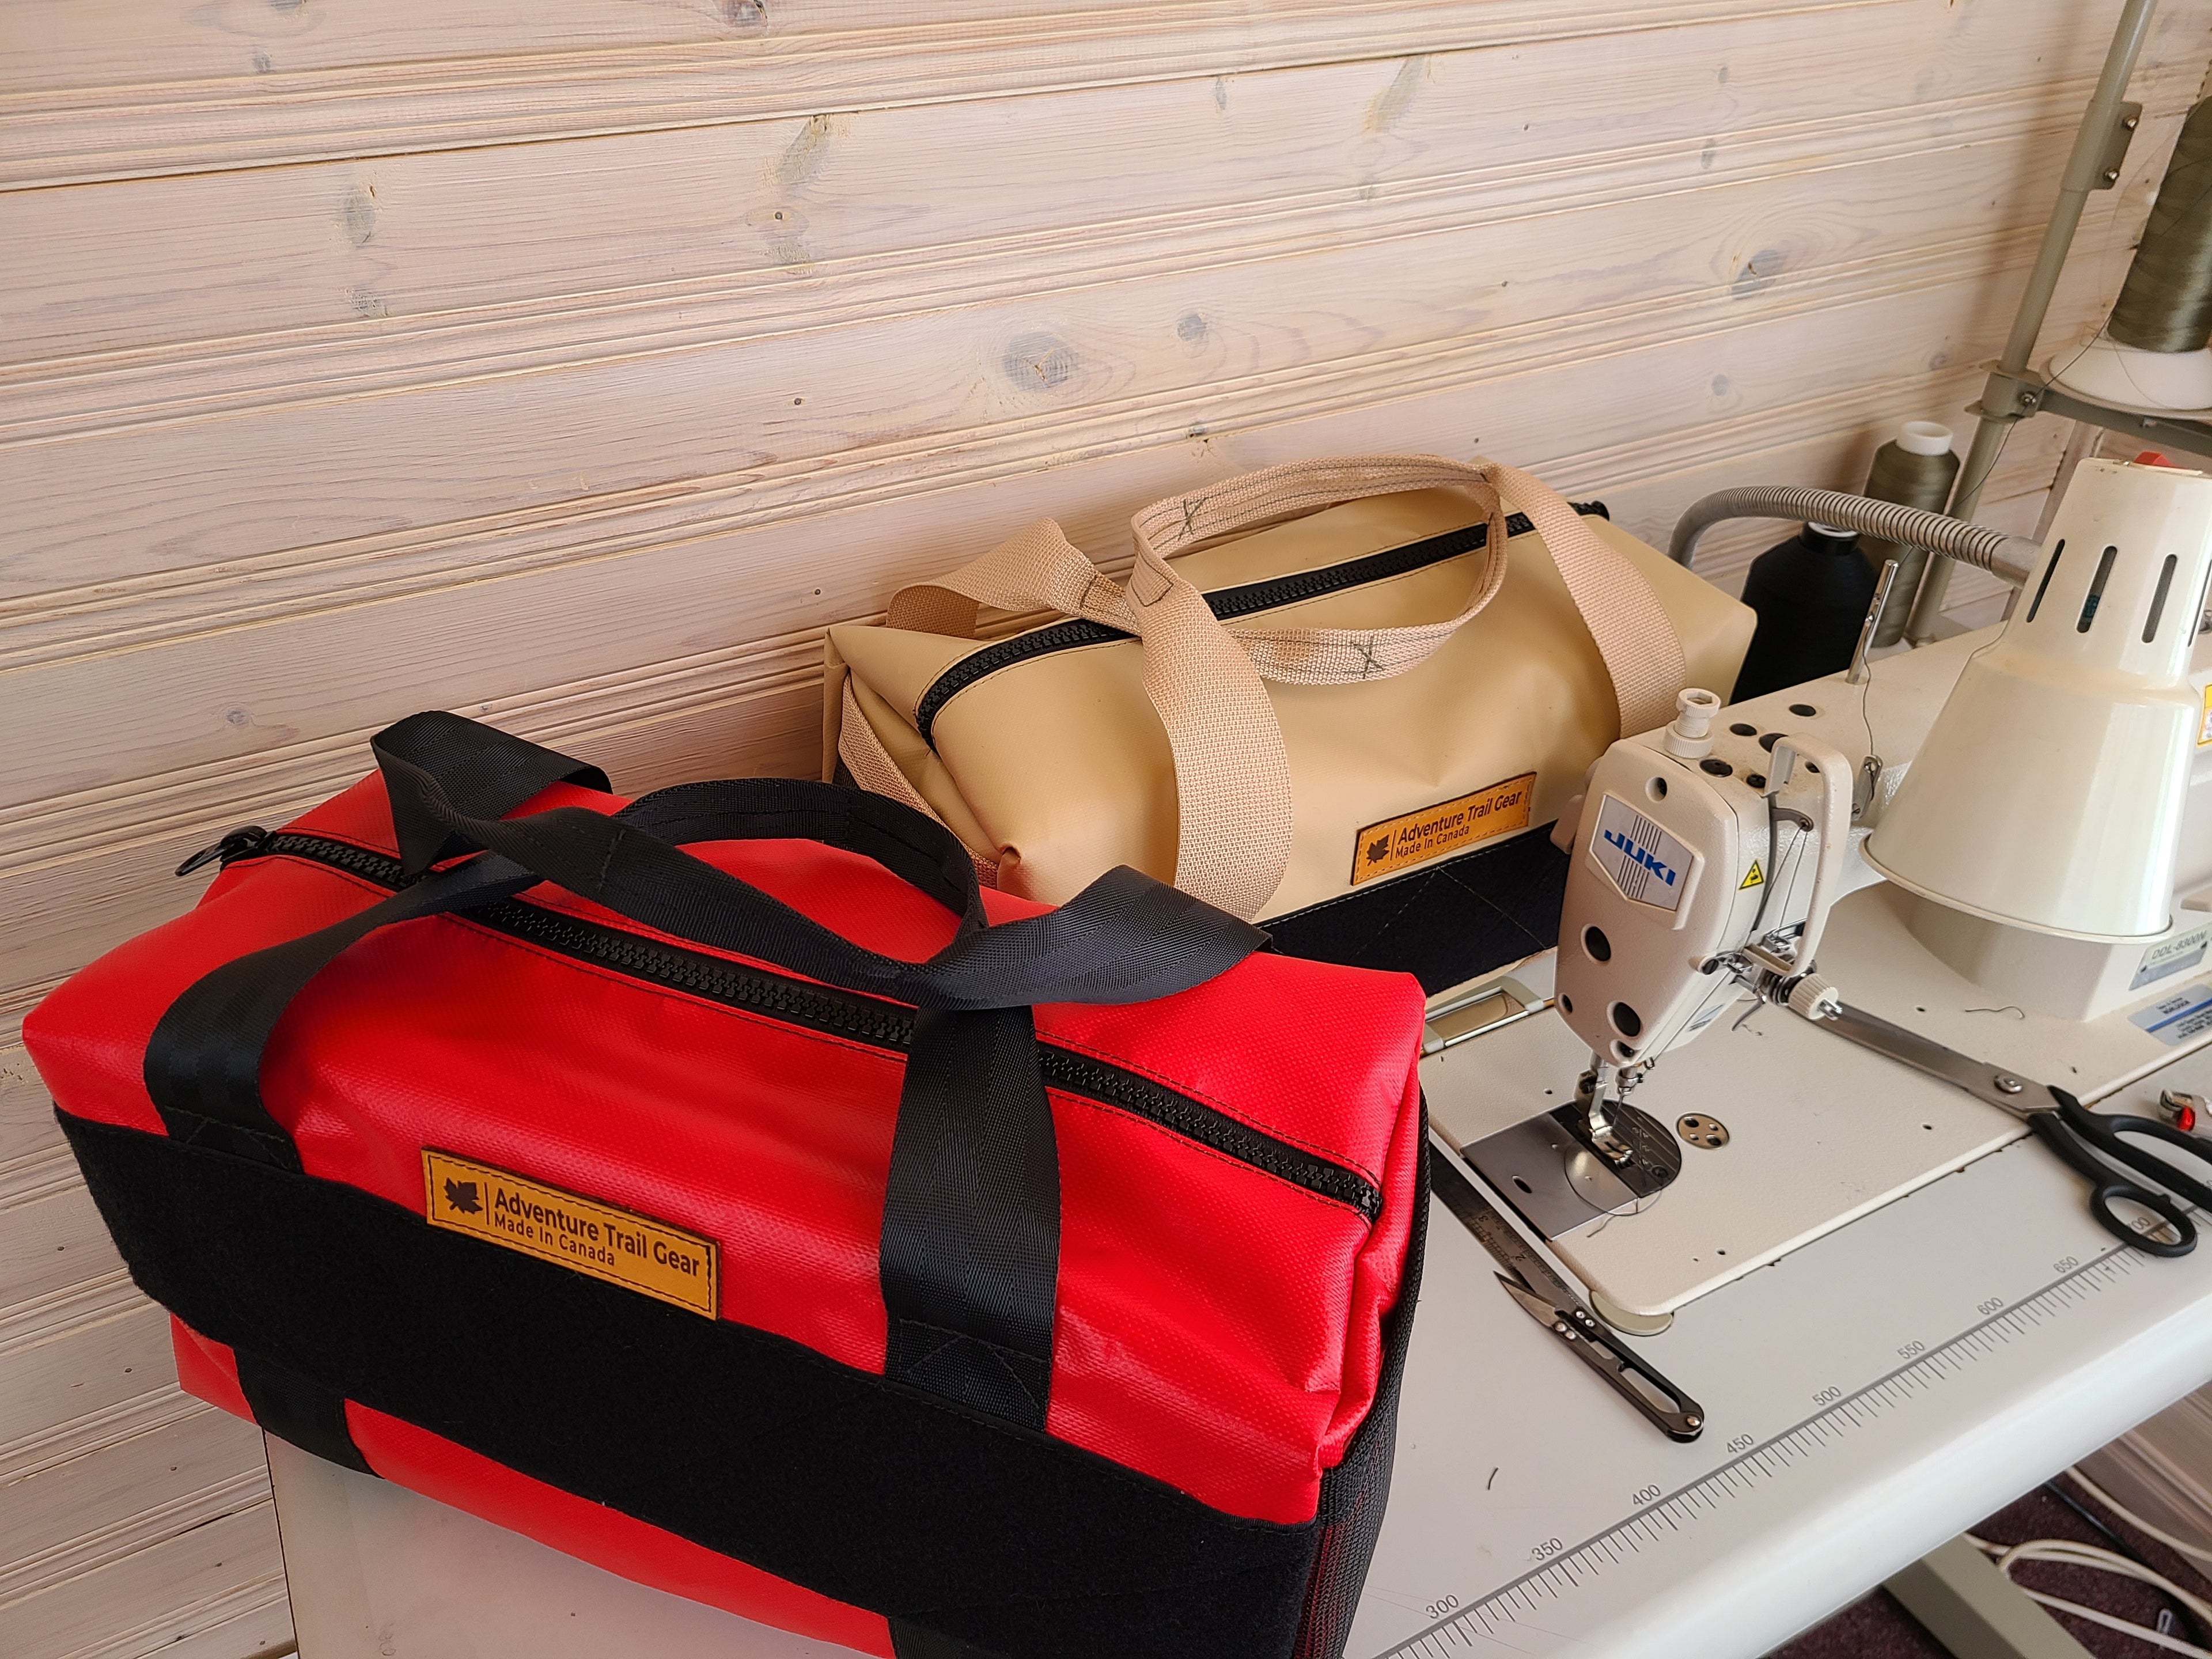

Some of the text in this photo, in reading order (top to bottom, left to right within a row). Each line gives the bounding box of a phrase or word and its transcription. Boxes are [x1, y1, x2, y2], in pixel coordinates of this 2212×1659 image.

[1397, 791, 1522, 845] Adventure Trail Gear
[1395, 825, 1469, 859] Made In Canada
[1604, 830, 1676, 886] JUKI
[2152, 930, 2207, 959] DDL-8300N
[495, 1188, 699, 1277] Adventure Trail Gear
[2128, 1217, 2150, 1230] 00
[495, 1211, 615, 1266] Made In Canada
[2053, 1256, 2078, 1273] 650
[1977, 1297, 2003, 1315] 600
[1897, 1340, 1925, 1359] 550
[1812, 1386, 1841, 1406] 500
[1726, 1434, 1754, 1454] 450
[1631, 1484, 1661, 1507] 400
[1531, 1537, 1563, 1561] 350
[1425, 1594, 1459, 1619] 300
